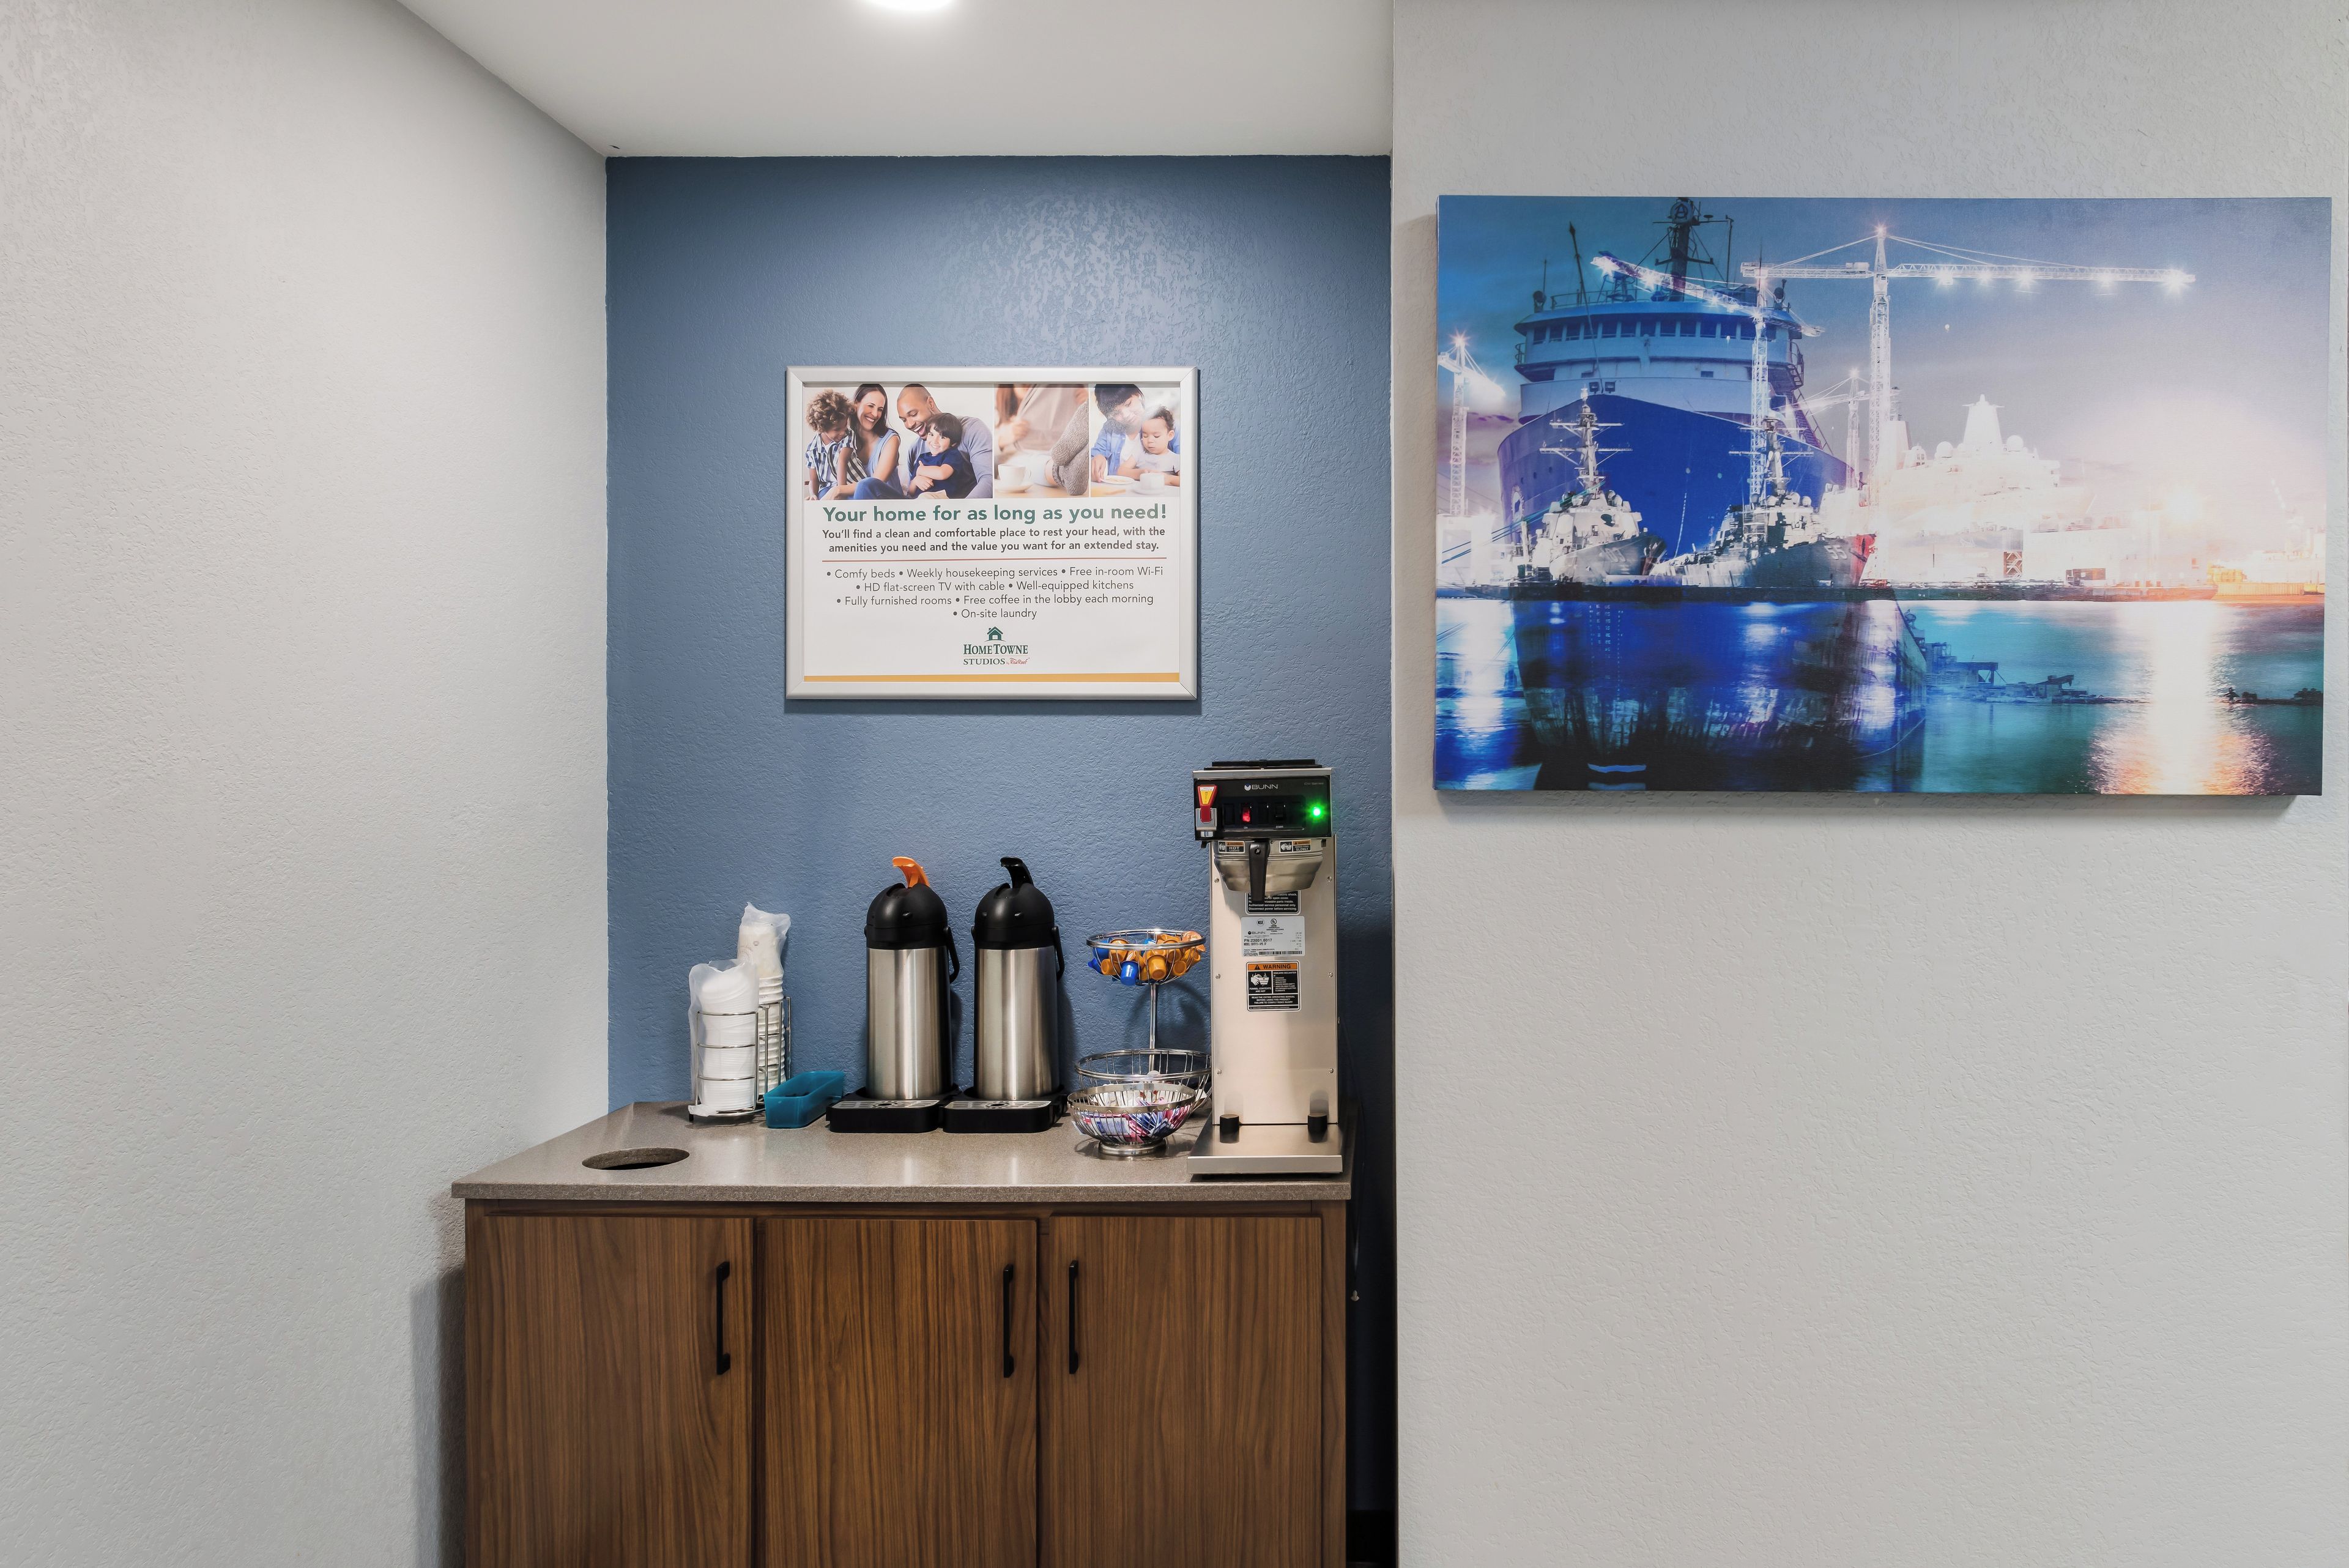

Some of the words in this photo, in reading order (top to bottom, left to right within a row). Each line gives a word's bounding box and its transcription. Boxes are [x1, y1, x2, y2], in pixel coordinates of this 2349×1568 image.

[822, 507, 867, 522] Your
[874, 505, 926, 522] home
[932, 505, 961, 521] for
[967, 509, 987, 521] as
[994, 504, 1036, 525] long
[1042, 509, 1063, 520] as
[1069, 508, 1104, 524] you
[1111, 503, 1166, 519] need!
[852, 529, 872, 538] find
[885, 528, 910, 538] clean
[913, 528, 932, 538] and
[935, 527, 996, 538] comfortable
[1000, 527, 1026, 540] place
[1028, 528, 1040, 537] to
[1043, 528, 1063, 537] rest
[1065, 529, 1089, 539] your
[1091, 526, 1119, 537] head,
[1123, 526, 1146, 536] with
[1148, 526, 1165, 536] the
[828, 543, 877, 552] amenities
[880, 545, 899, 555] you
[902, 541, 926, 552] need
[929, 541, 948, 551] and
[951, 541, 968, 551] the
[971, 541, 998, 551] value
[1000, 543, 1020, 553] you
[1022, 541, 1048, 550] want
[1050, 540, 1066, 550] for
[1083, 540, 1132, 549] extended
[1135, 541, 1159, 552] stay.
[1824, 544, 1847, 560] 55
[834, 568, 868, 581] Comfy
[870, 568, 896, 578] beds
[907, 568, 943, 581] Weekly
[946, 567, 1015, 581] housekeeping
[1018, 567, 1058, 577] services
[1070, 567, 1092, 576] Free
[1095, 566, 1134, 576] in-room
[1137, 566, 1163, 576] Wi-Fi
[864, 582, 880, 592] HD
[883, 582, 935, 592] flat-screen
[938, 582, 952, 591] TV
[954, 581, 976, 591] with
[978, 581, 1005, 591] cable
[1016, 579, 1089, 593] Well-equipped
[1093, 579, 1134, 590] kitchens
[845, 595, 868, 608] Fully
[870, 595, 918, 606] furnished
[963, 595, 986, 604] Free
[989, 594, 1020, 604] coffee
[1023, 594, 1031, 604] in
[1034, 593, 1051, 604] the
[1054, 593, 1082, 606] lobby
[1085, 593, 1108, 603] each
[1111, 593, 1154, 606] morning
[961, 608, 998, 619] On-site
[1001, 608, 1037, 620] laundry
